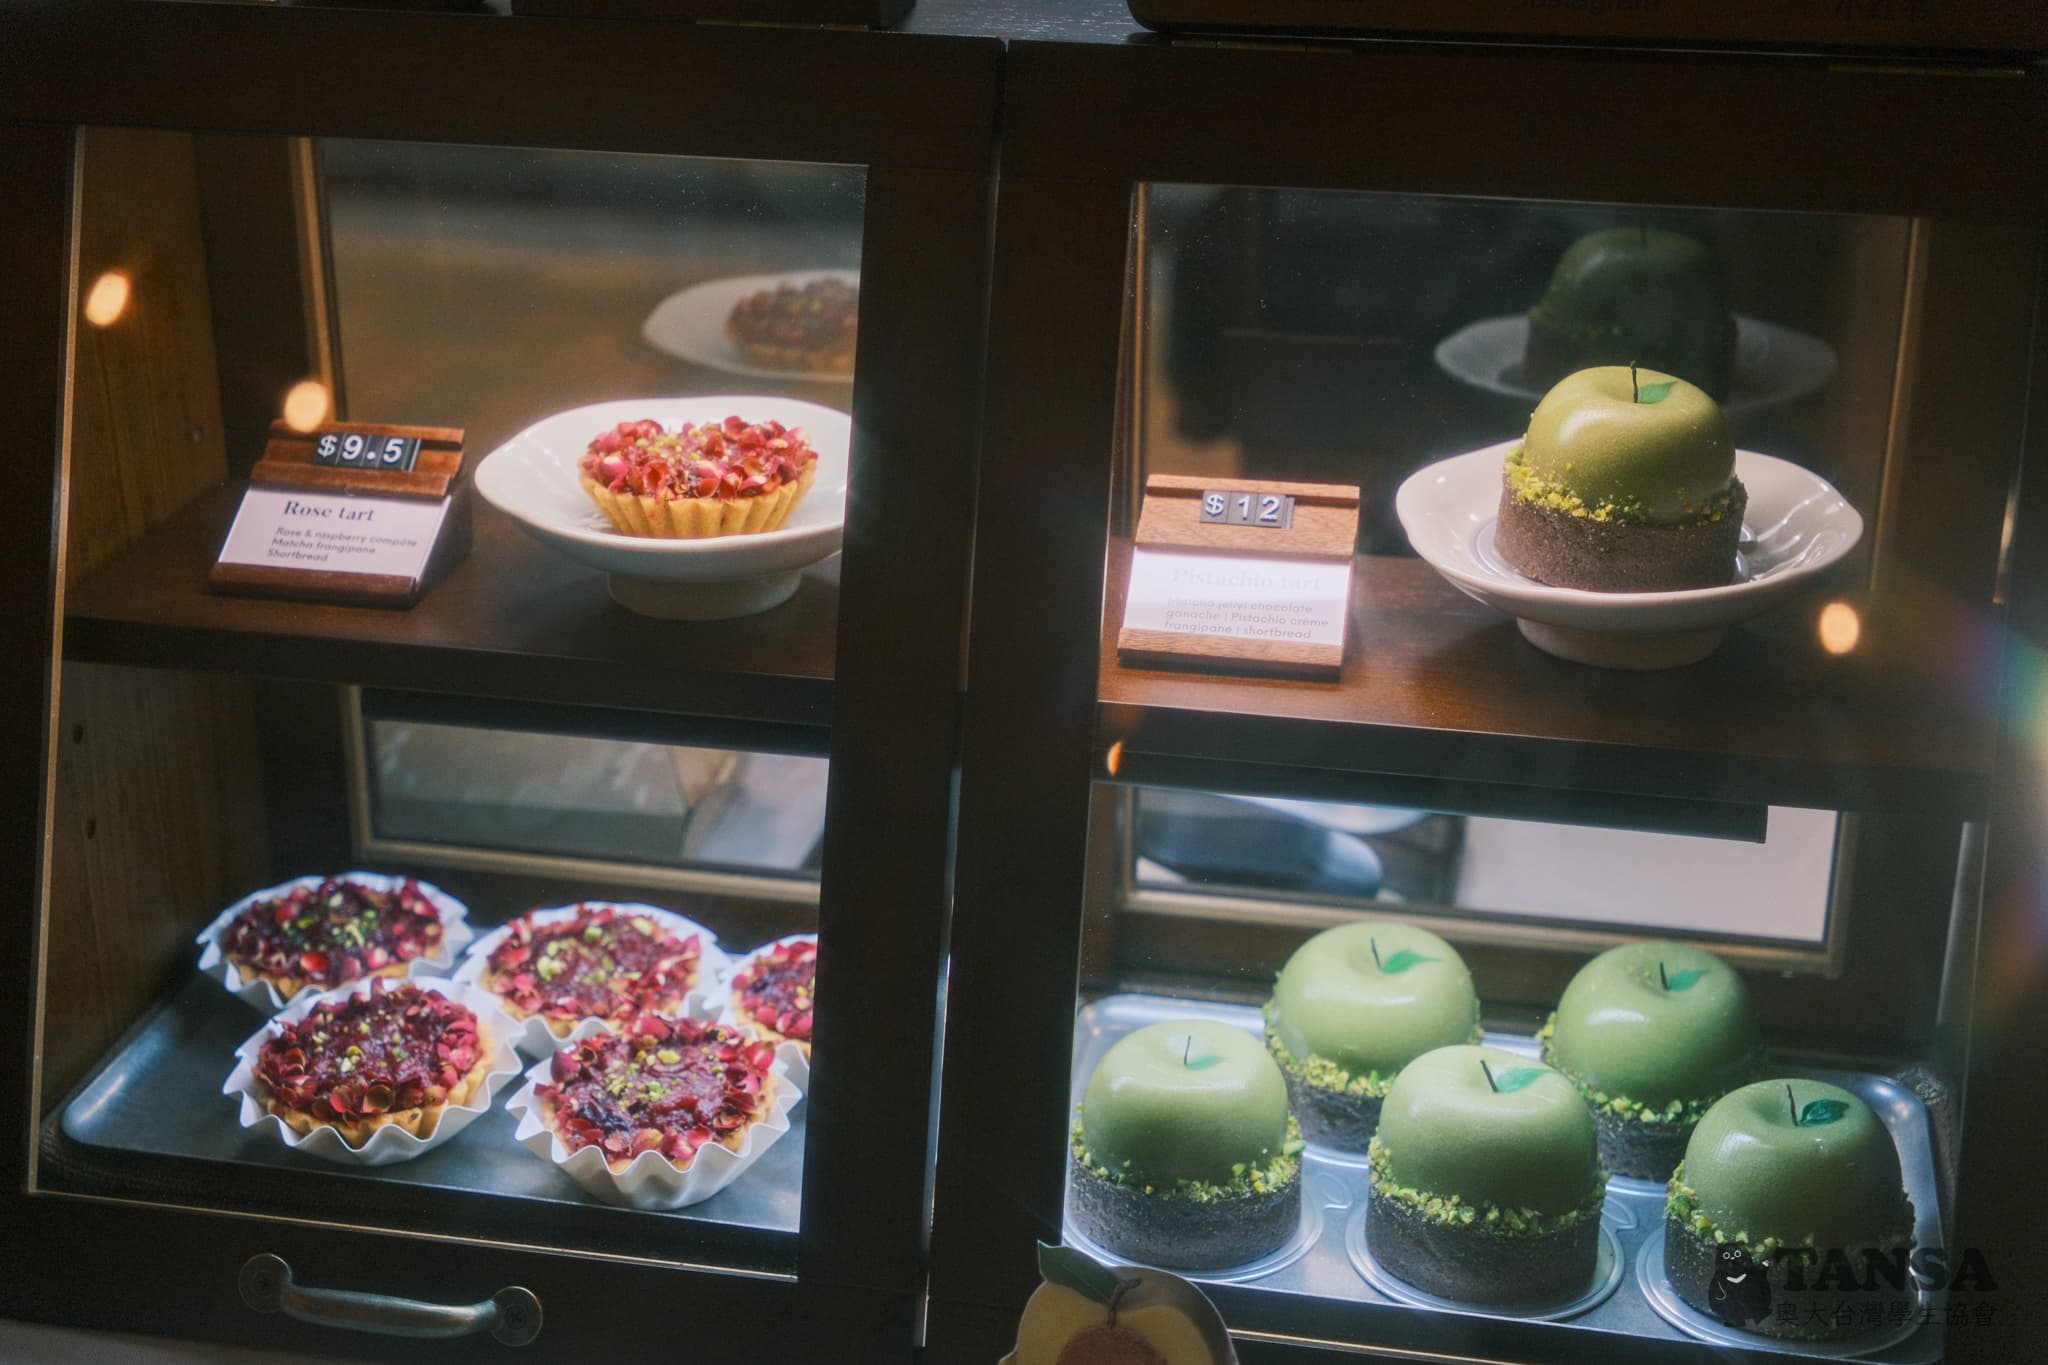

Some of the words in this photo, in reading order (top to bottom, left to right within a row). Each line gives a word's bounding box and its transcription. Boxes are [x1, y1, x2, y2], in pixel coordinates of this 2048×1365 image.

[317, 434, 404, 463] $9.5
[284, 500, 332, 516] Rose
[338, 505, 375, 521] tart
[275, 527, 302, 537] Rose
[304, 529, 313, 538] &
[315, 530, 368, 545] raspberry
[271, 537, 313, 549] Matcha
[316, 541, 376, 555] frangipane
[267, 549, 329, 562] Shortbread
[1171, 567, 1273, 589] Pistachio
[1281, 576, 1321, 592] tart
[1250, 600, 1312, 614] chocolate
[1165, 608, 1221, 621] ganache
[1231, 612, 1287, 625] Pistachio
[1164, 620, 1232, 634] frangipane
[1243, 625, 1312, 639] shortbread
